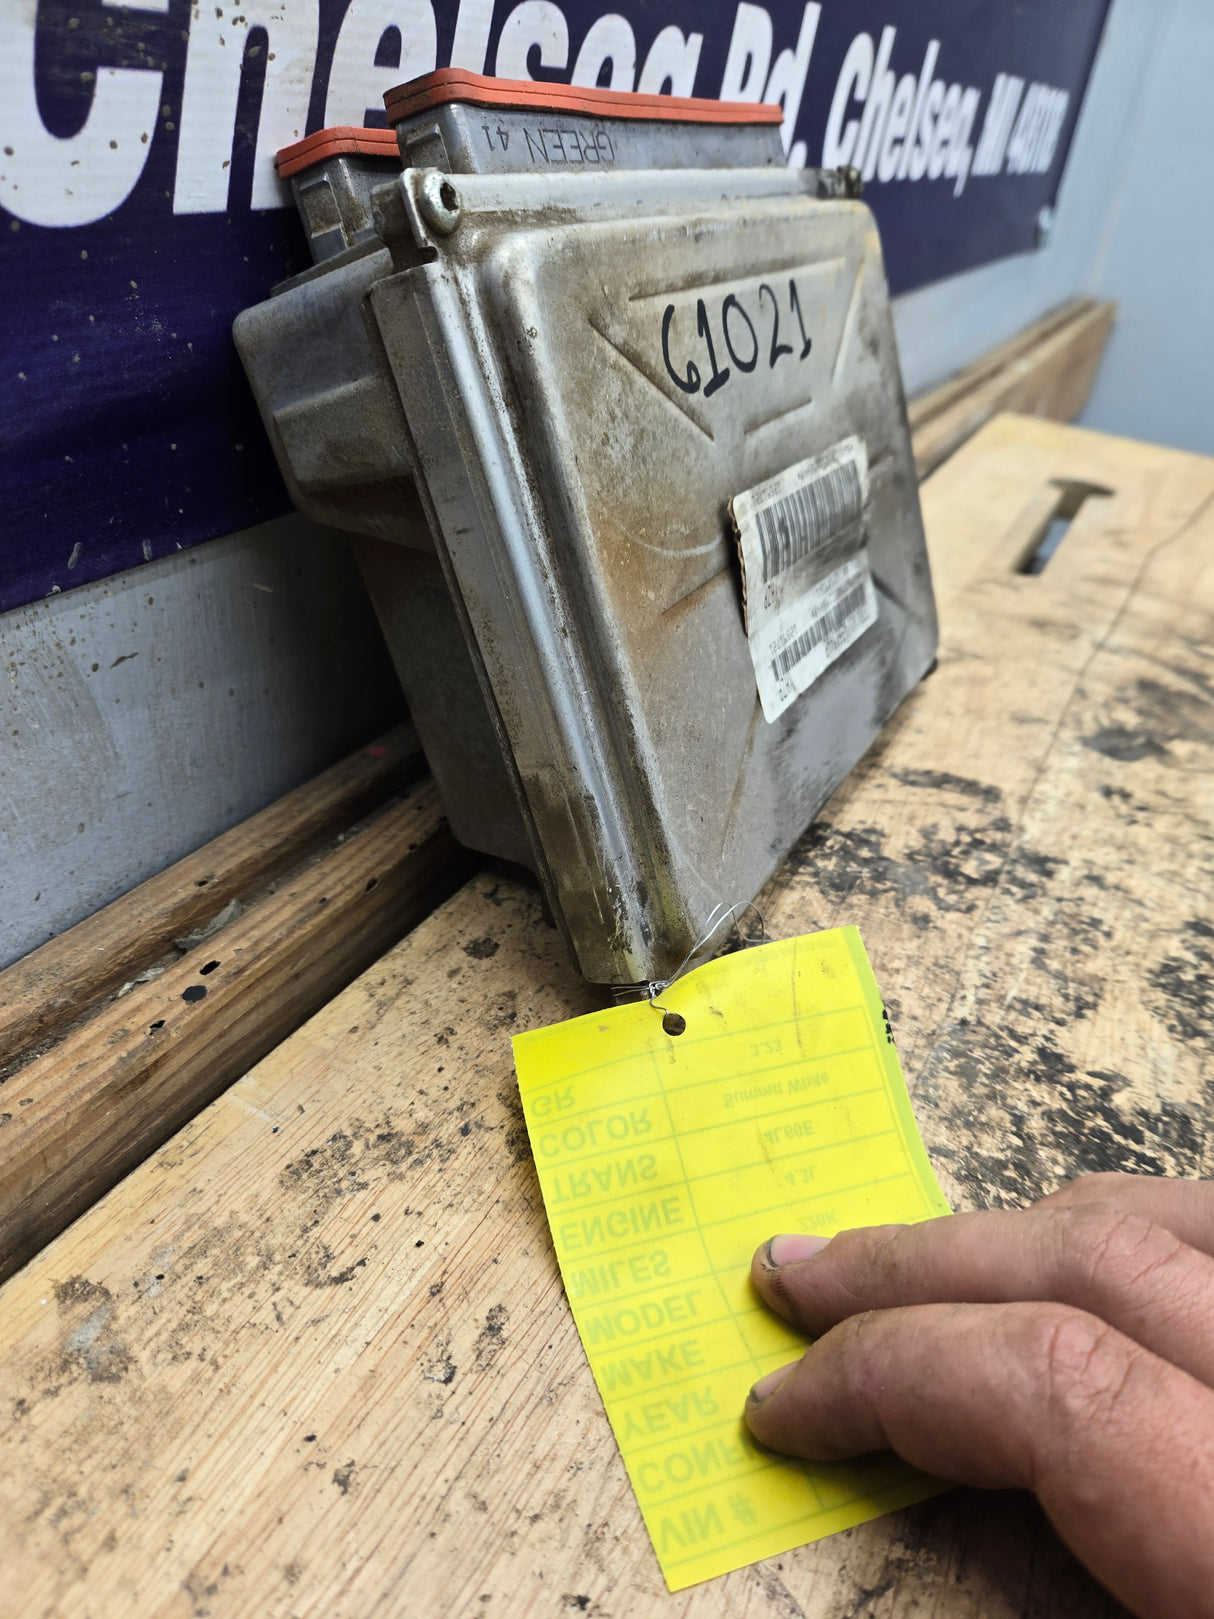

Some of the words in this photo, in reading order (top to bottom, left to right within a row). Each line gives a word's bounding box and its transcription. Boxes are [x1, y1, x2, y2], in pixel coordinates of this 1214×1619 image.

[481, 125, 509, 152] 41
[523, 127, 615, 164] GREEN
[821, 25, 981, 198] Chelsea,
[662, 279, 812, 397] 61021
